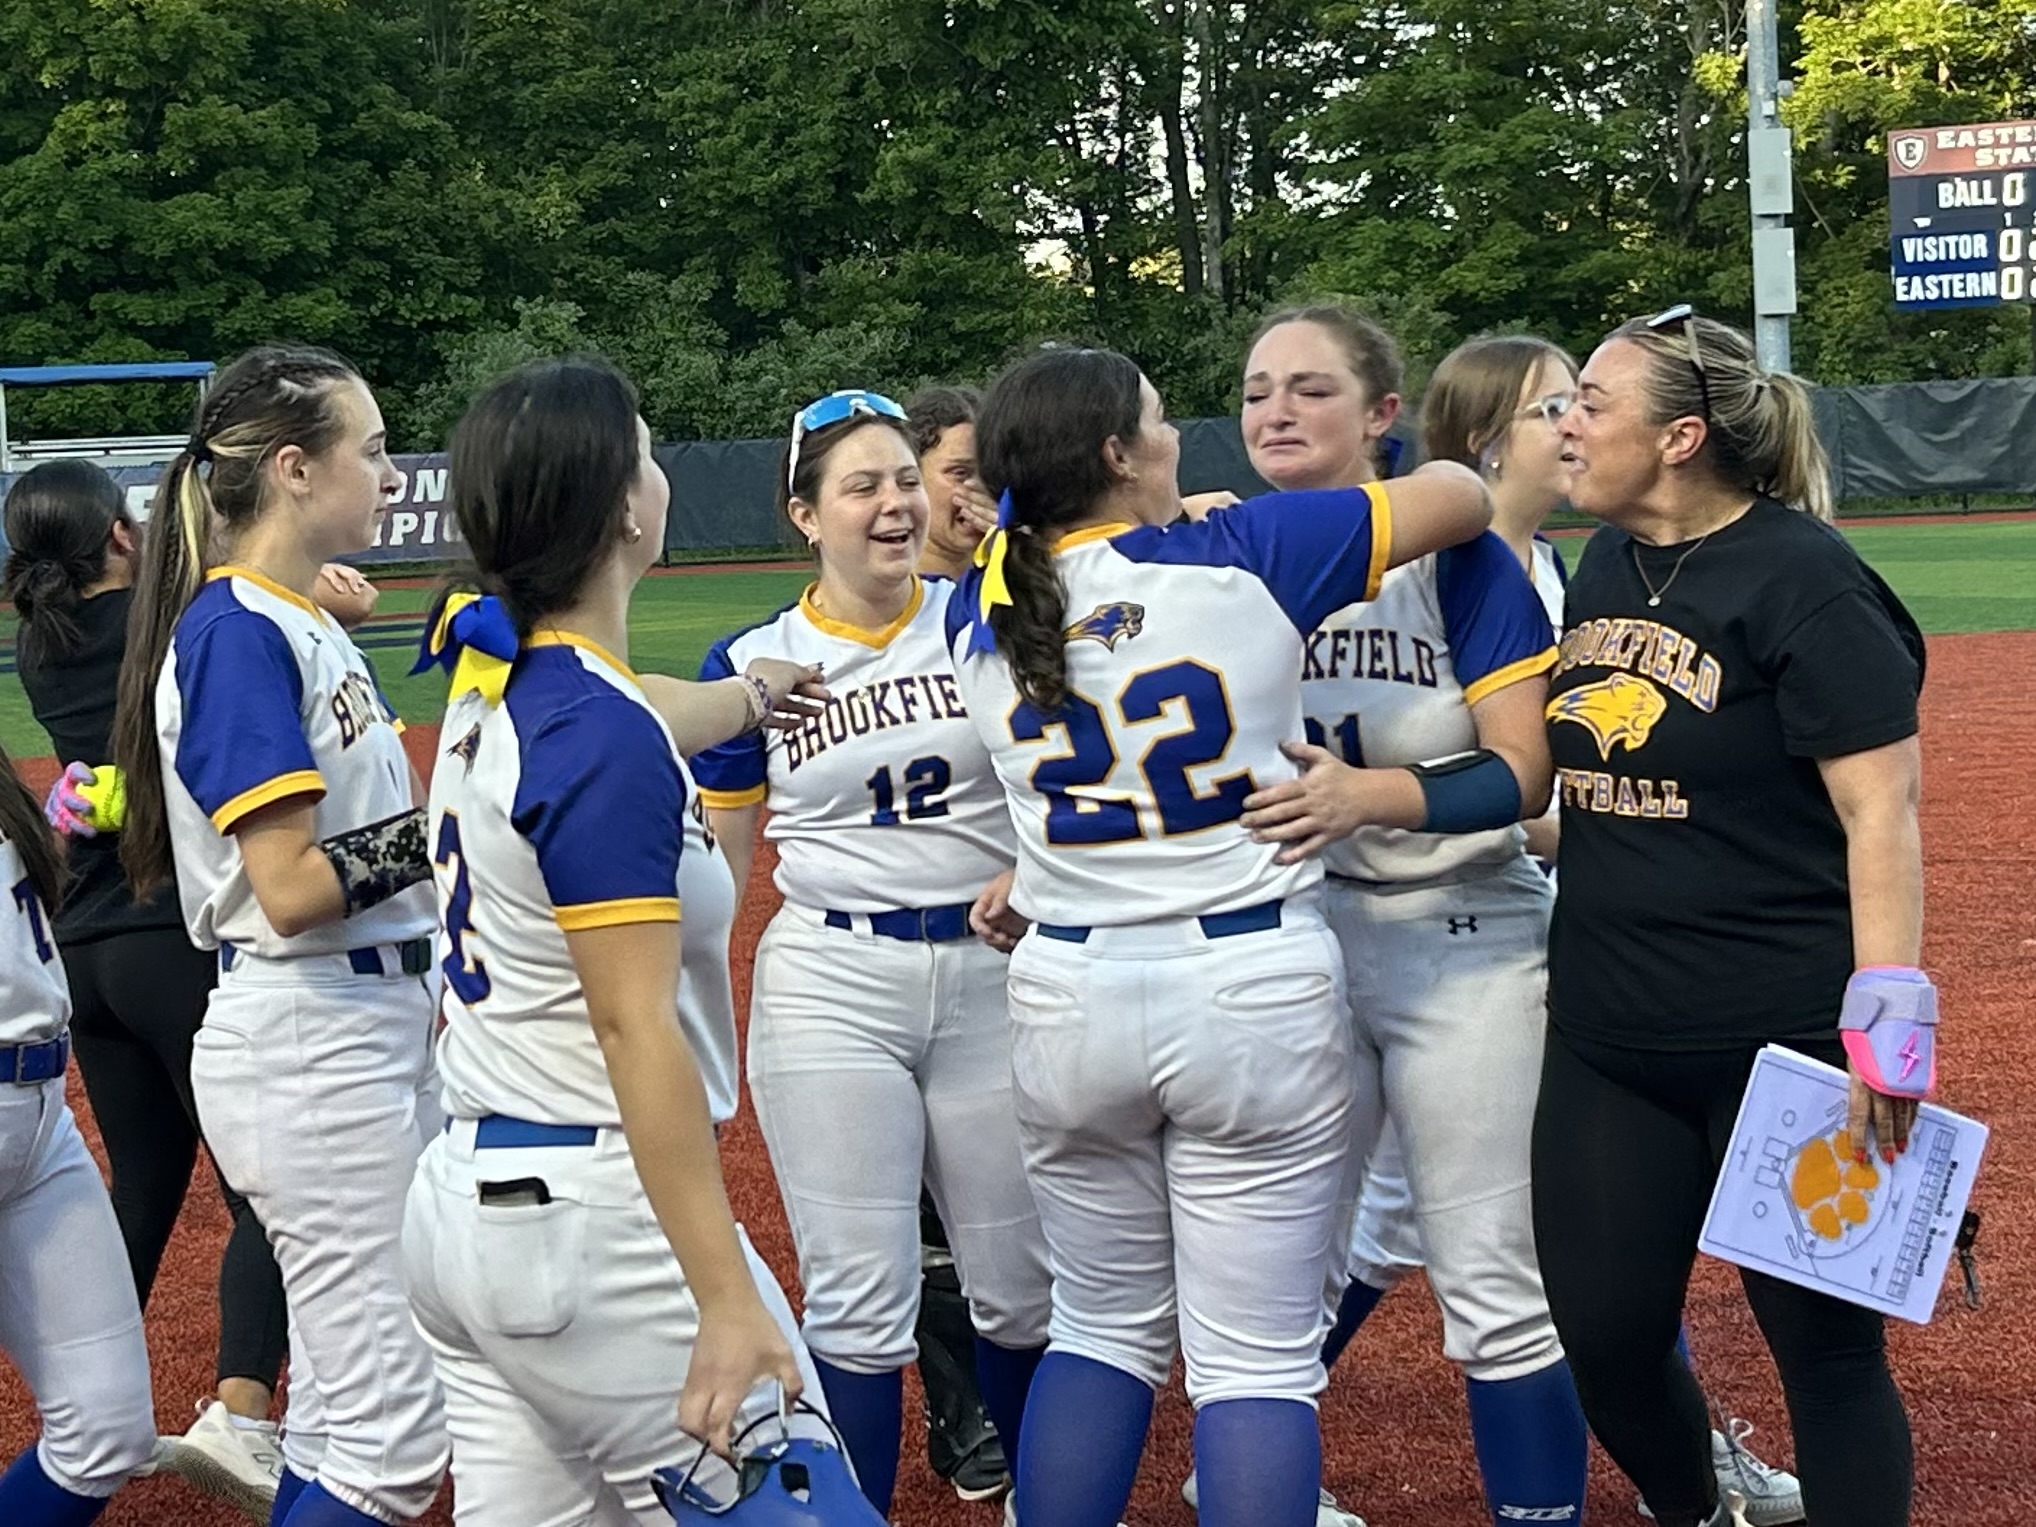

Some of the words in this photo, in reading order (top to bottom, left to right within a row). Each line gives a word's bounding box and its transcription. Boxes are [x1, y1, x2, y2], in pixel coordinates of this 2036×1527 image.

[1936, 125, 2036, 149] EASTE
[1937, 178, 1997, 208] BALL
[2003, 172, 2024, 206] 0
[1902, 233, 1988, 263] VISITOR
[1999, 229, 2022, 262] 0
[1896, 271, 1996, 301] EASTERN
[2001, 267, 2023, 300] 0
[1005, 656, 1258, 848] 22
[866, 755, 951, 826] 12
